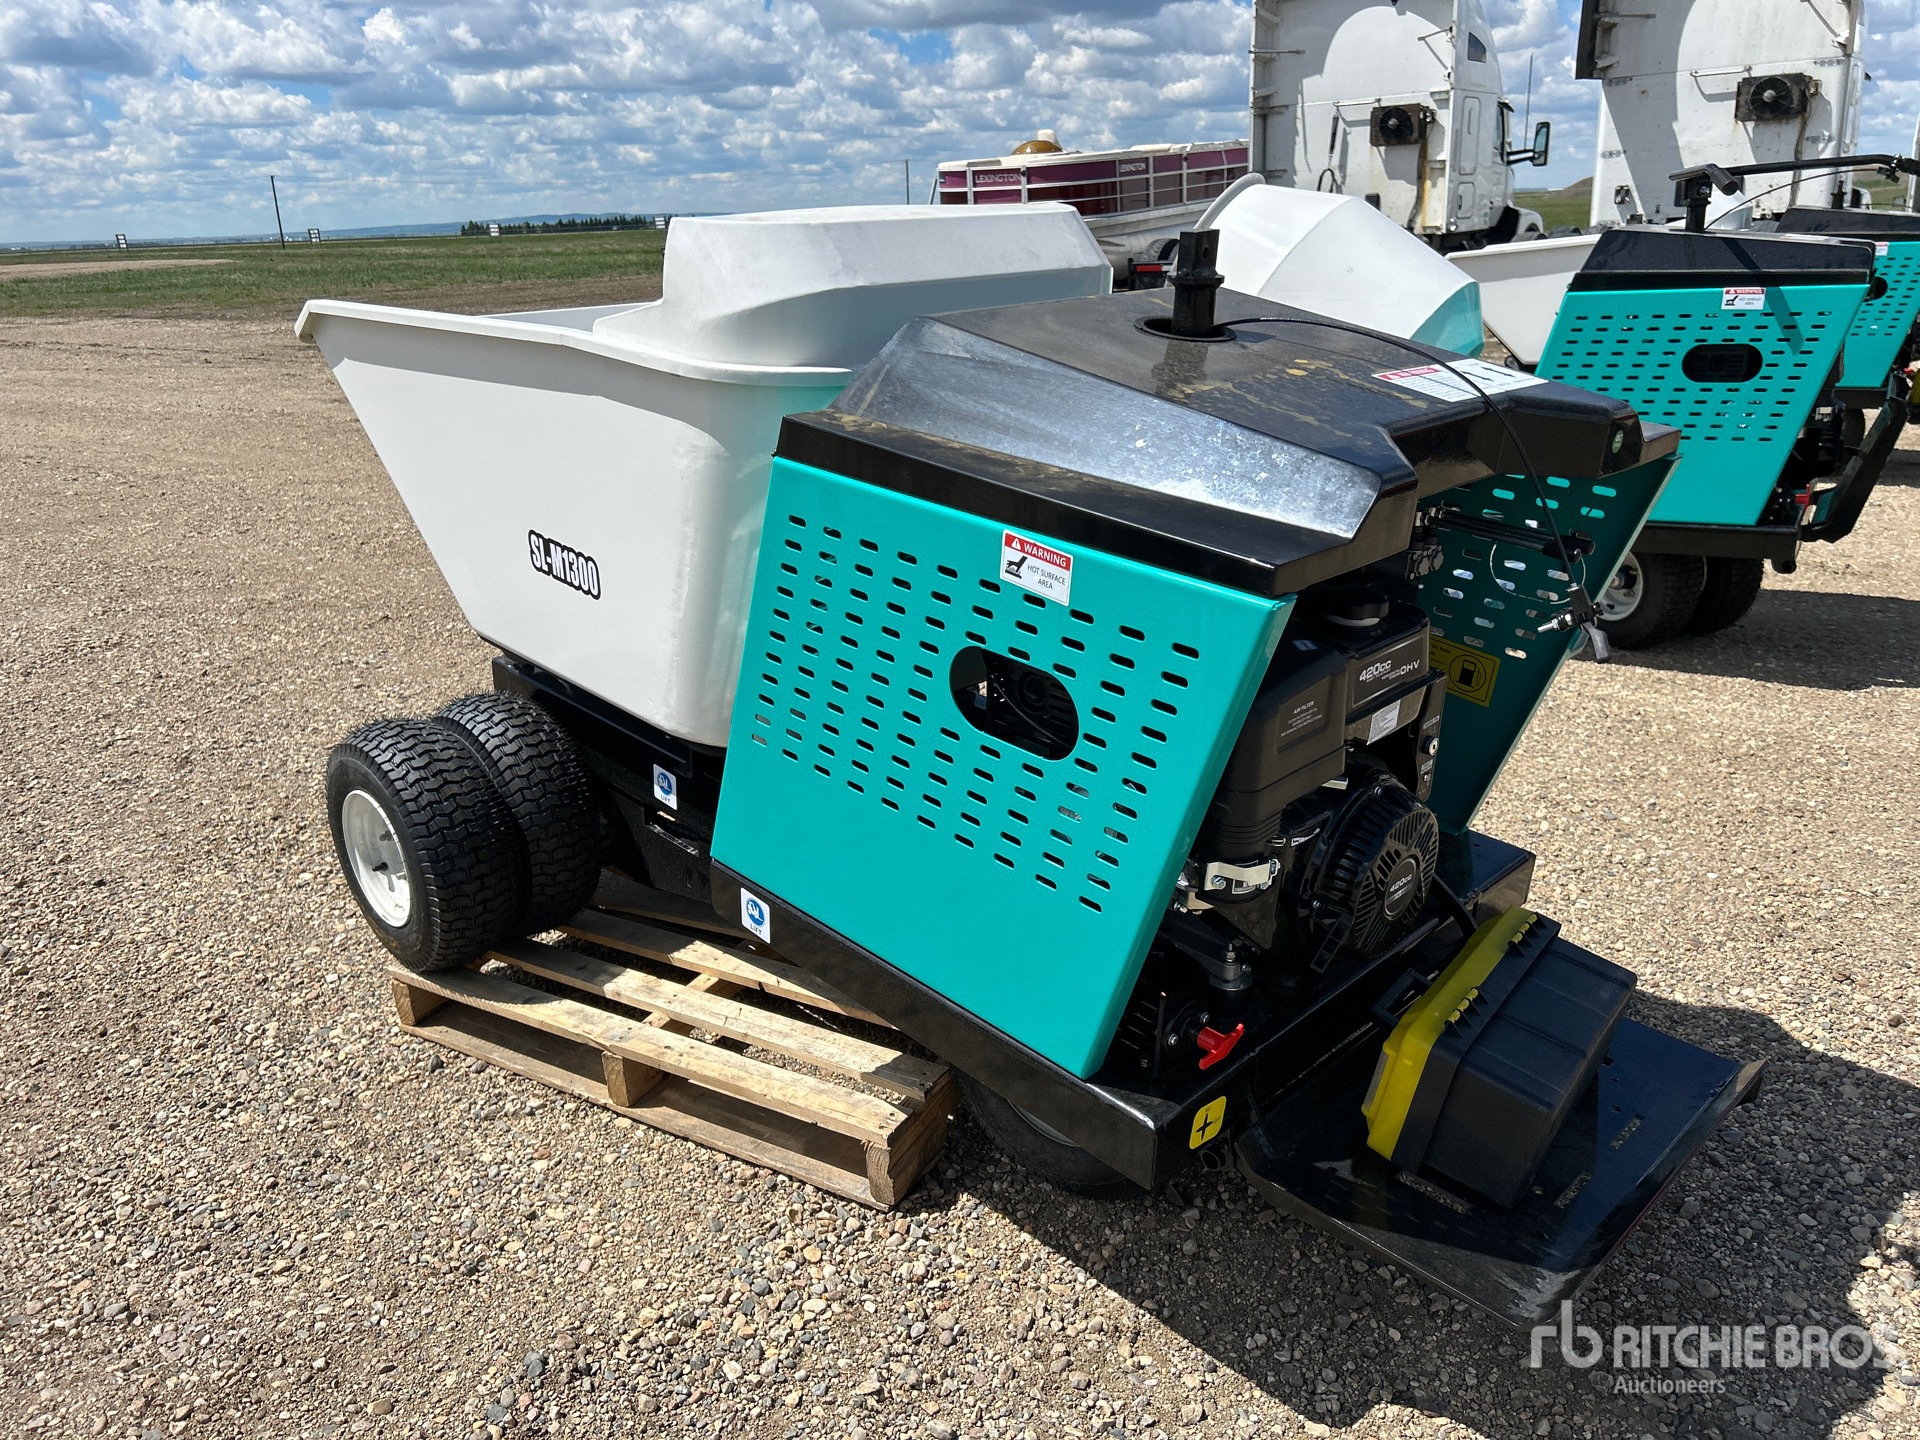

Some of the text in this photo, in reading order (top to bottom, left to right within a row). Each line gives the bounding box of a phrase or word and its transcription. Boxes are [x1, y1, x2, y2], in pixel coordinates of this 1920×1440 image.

[975, 173, 1021, 184] LEXINGTON
[1023, 542, 1067, 567] WARNING
[529, 531, 600, 598] SL-M1300
[1027, 563, 1066, 586] HOT SURFACE
[1037, 578, 1053, 590] AREA
[1359, 660, 1392, 681] 420cc
[1400, 659, 1420, 675] OHV
[750, 923, 763, 936] LIFT
